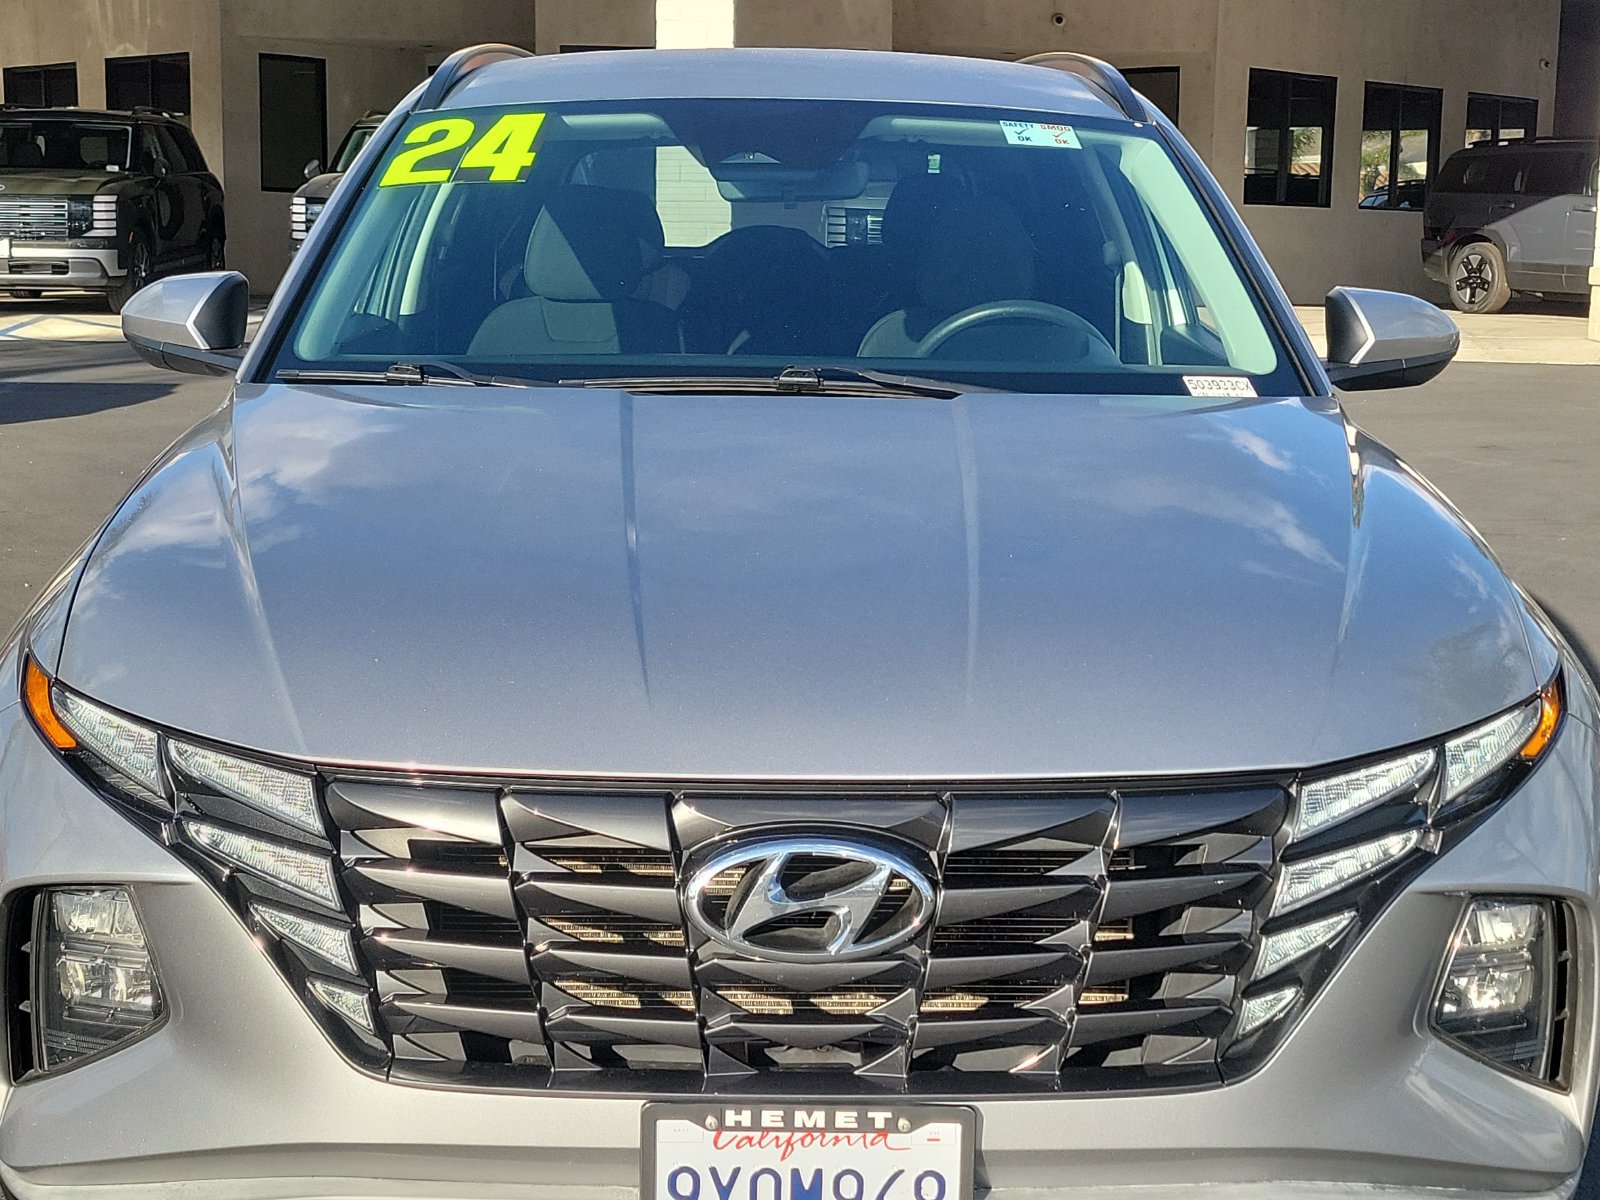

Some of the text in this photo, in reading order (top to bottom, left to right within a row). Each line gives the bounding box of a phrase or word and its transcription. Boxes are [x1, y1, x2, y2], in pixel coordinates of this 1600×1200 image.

[380, 113, 546, 187] 24
[724, 1109, 892, 1128] HEMET
[712, 1129, 911, 1162] California
